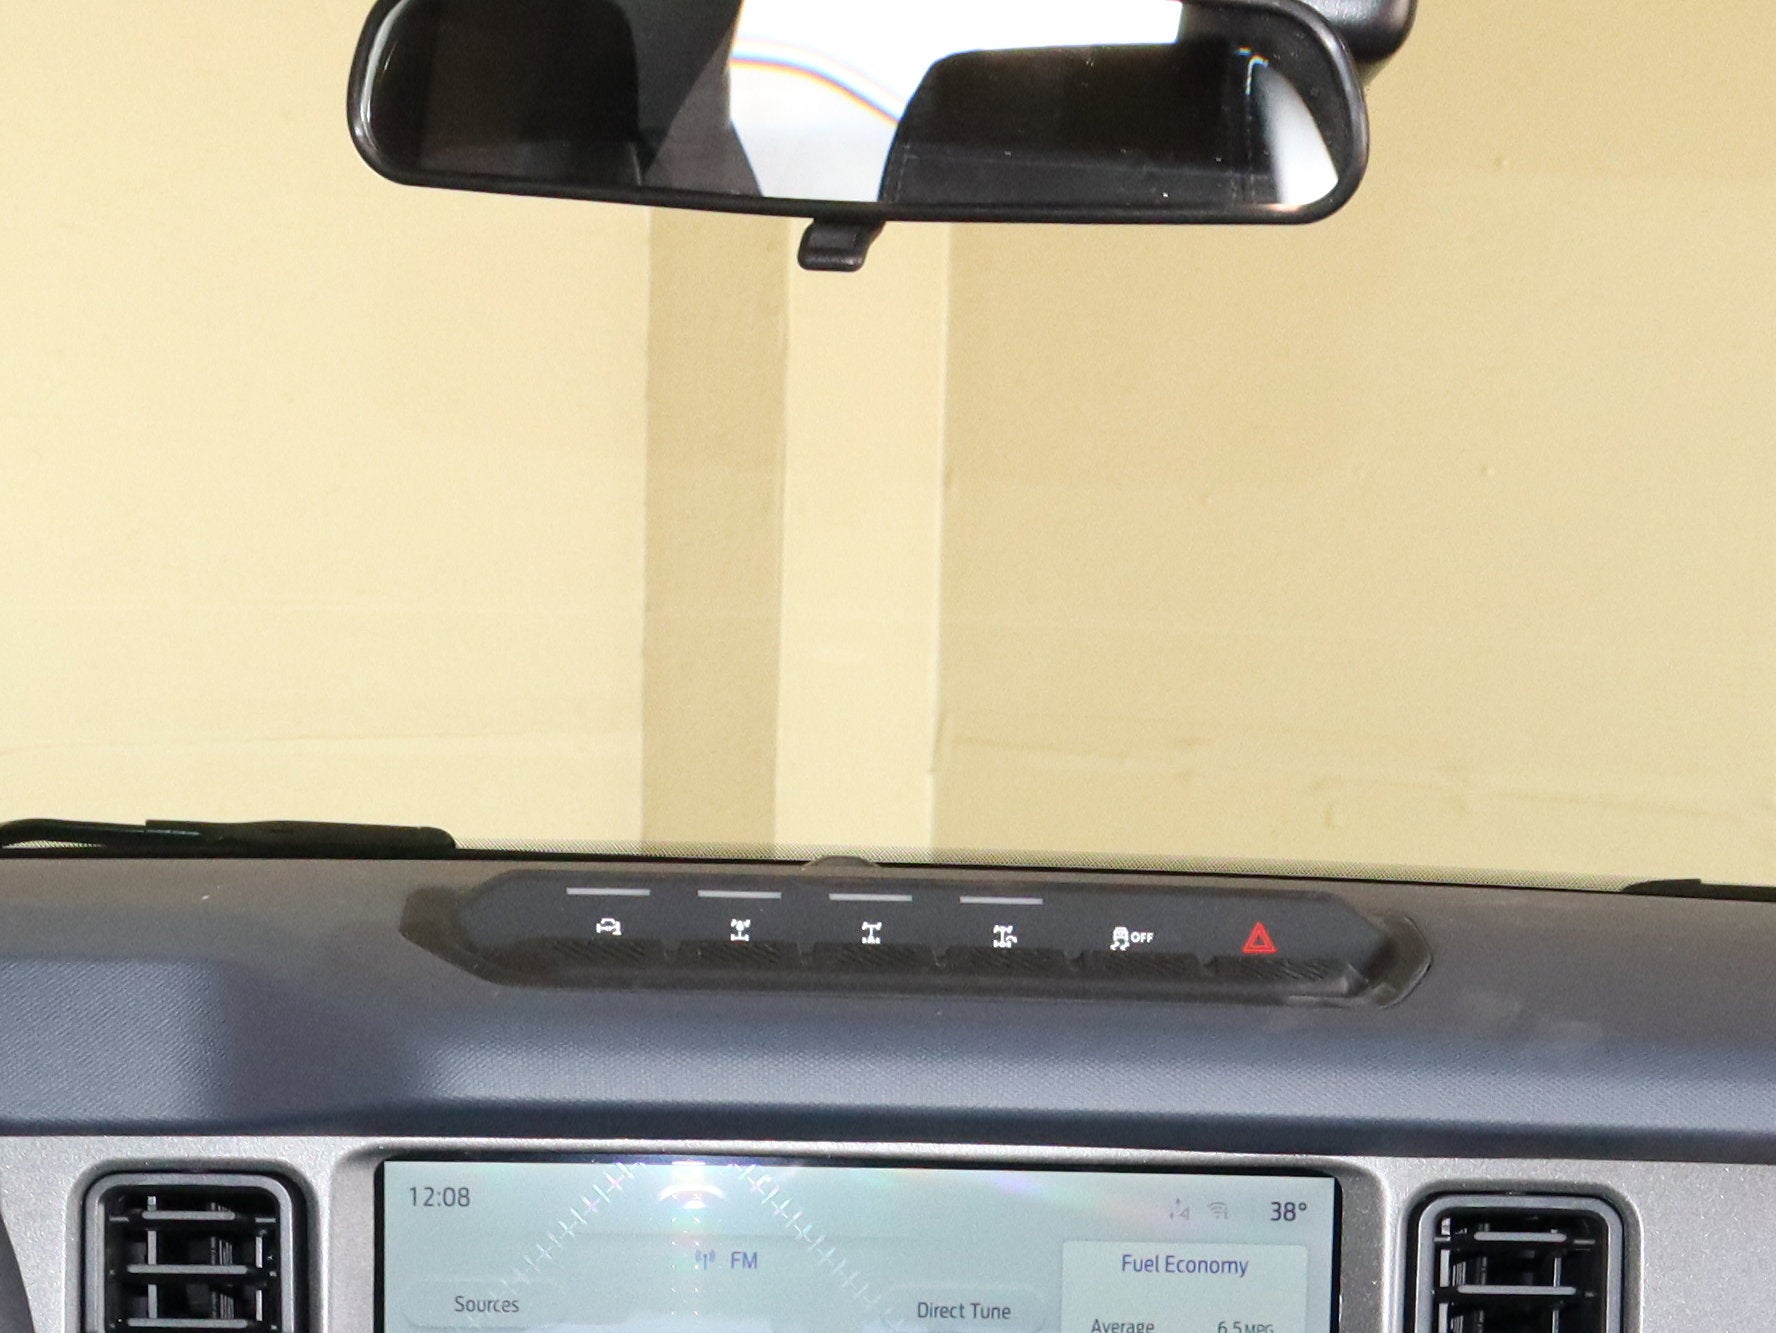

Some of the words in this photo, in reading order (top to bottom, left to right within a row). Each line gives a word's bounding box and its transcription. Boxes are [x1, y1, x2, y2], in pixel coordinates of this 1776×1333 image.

[1130, 932, 1153, 944] OFF
[410, 1187, 470, 1208] 12:08
[730, 1251, 758, 1270] FM
[1121, 1254, 1158, 1274] Fuel
[1164, 1255, 1248, 1278] Economy
[454, 1296, 519, 1314] Sources
[916, 1302, 963, 1320] Direct
[968, 1302, 1010, 1320] Tune
